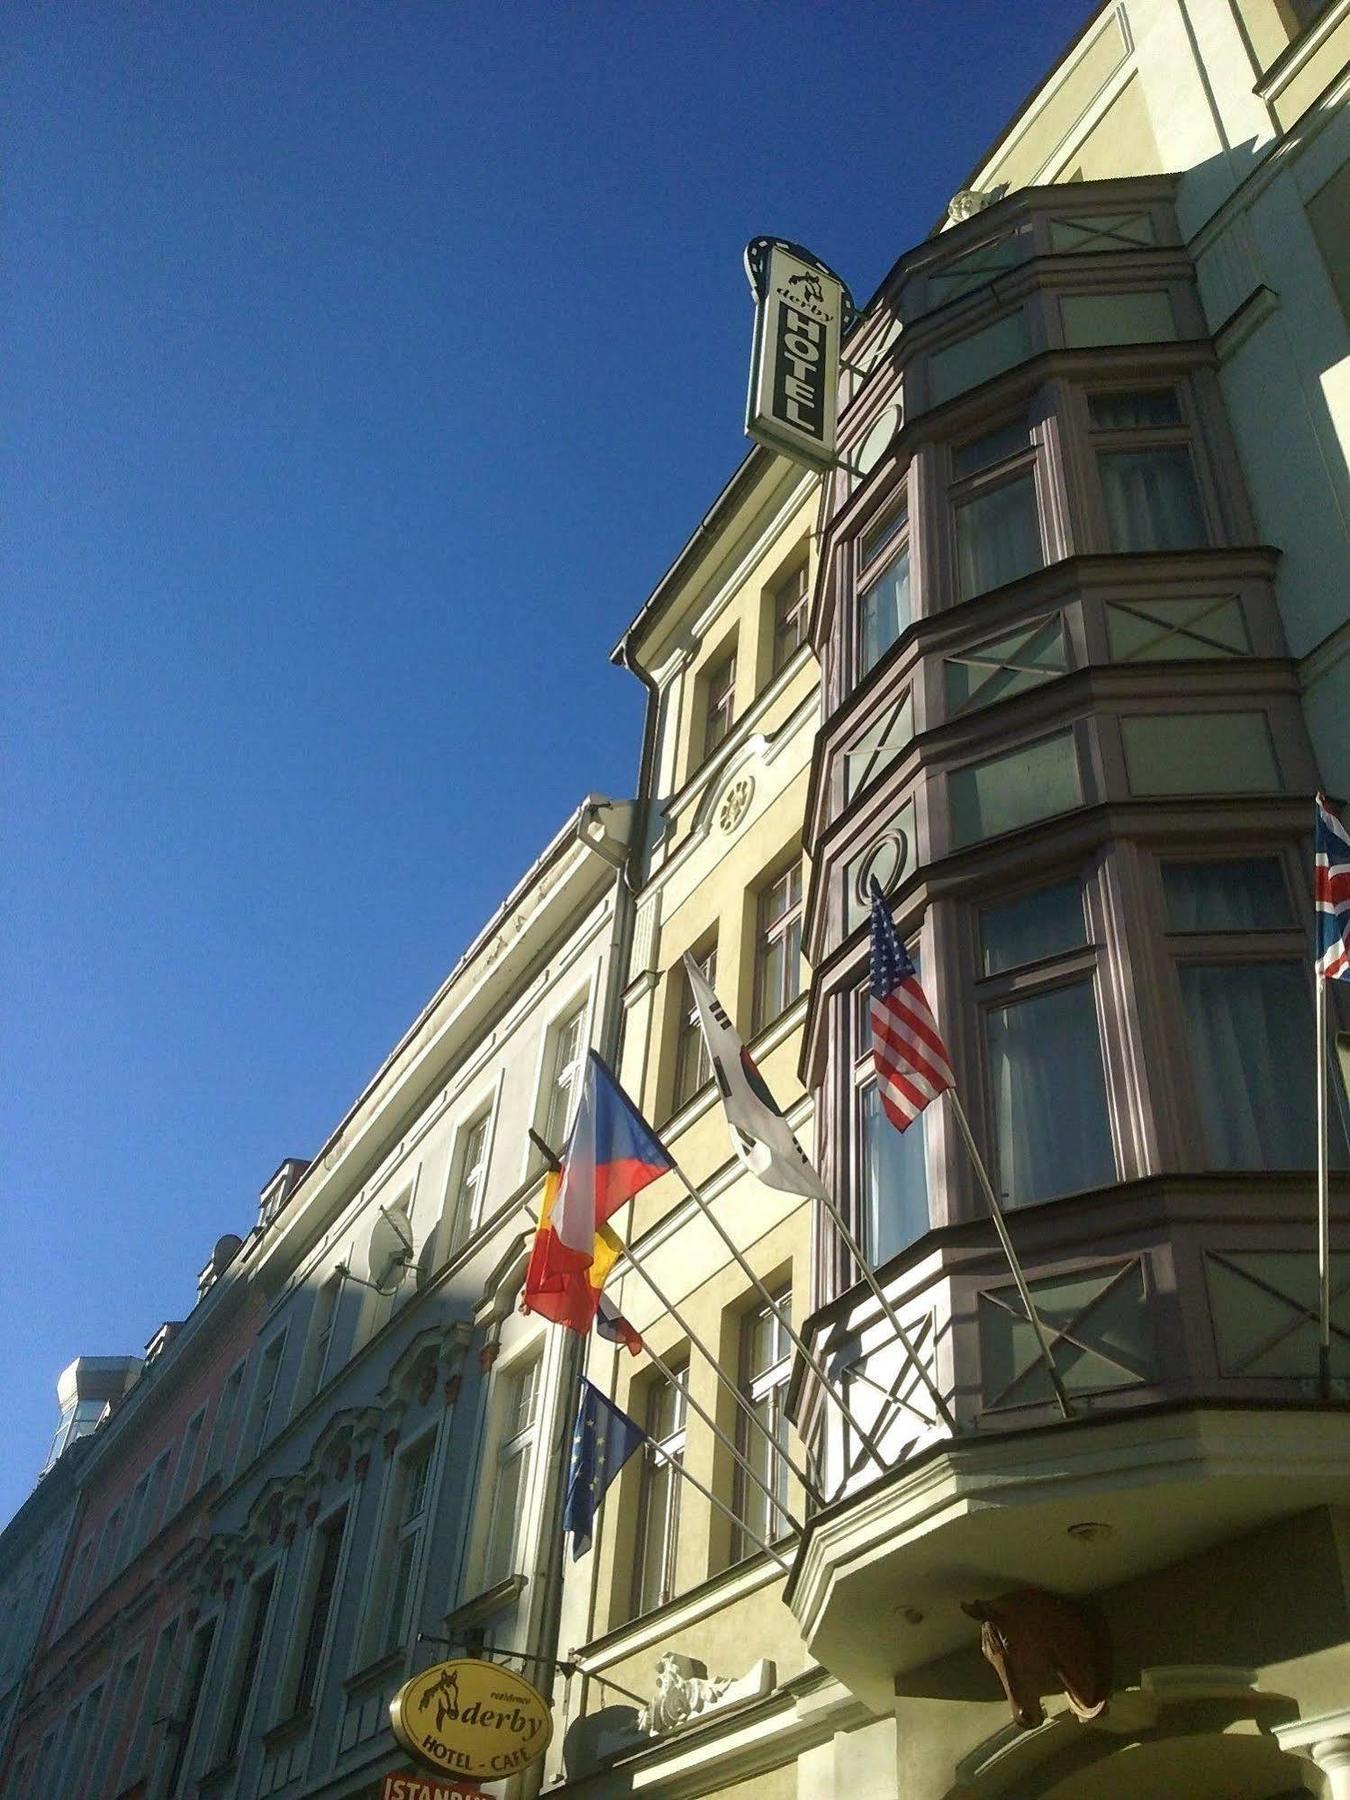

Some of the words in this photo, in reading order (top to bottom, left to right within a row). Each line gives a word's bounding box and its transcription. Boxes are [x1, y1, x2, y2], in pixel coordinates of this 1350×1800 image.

[776, 287, 834, 322] derby
[784, 308, 820, 431] HOTEL
[461, 1701, 542, 1742] derby
[422, 1734, 473, 1770] HOTEL
